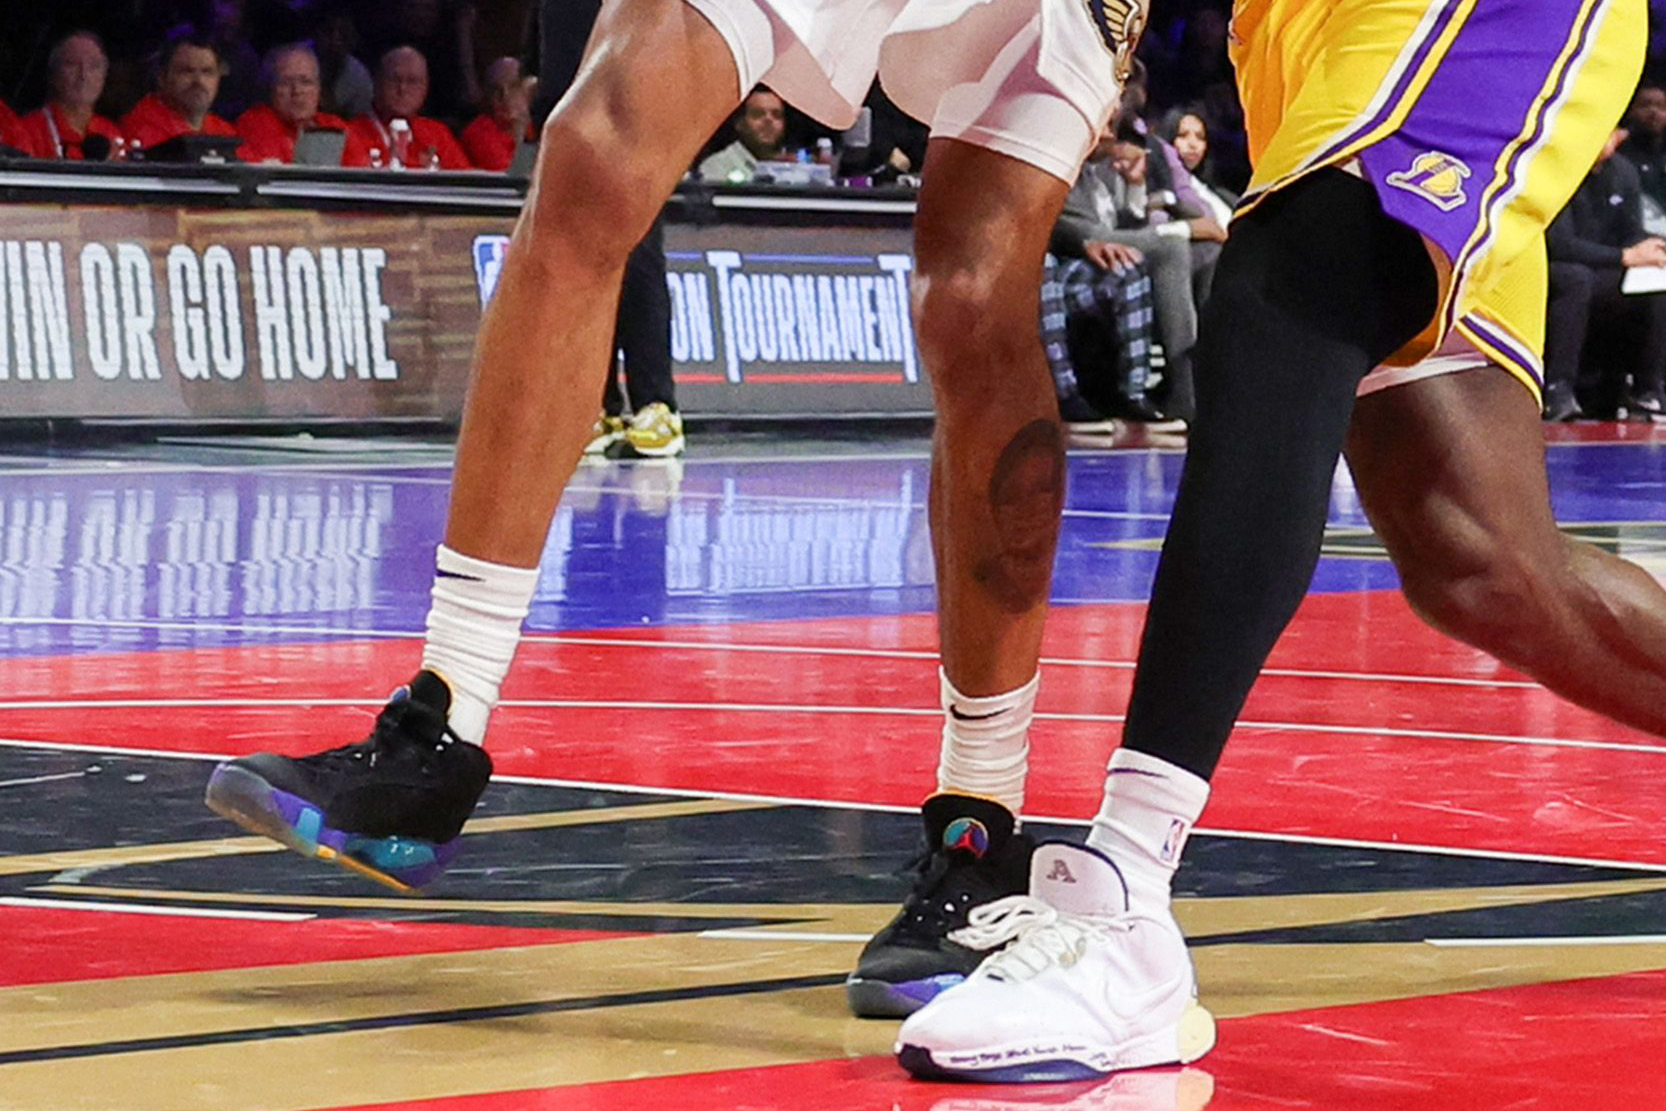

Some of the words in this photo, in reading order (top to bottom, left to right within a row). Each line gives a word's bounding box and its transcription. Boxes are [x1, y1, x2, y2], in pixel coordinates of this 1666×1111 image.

[81, 242, 162, 380] OR
[167, 244, 245, 380] GO
[250, 245, 398, 380] HOME
[706, 250, 918, 383] TOURNAMENT
